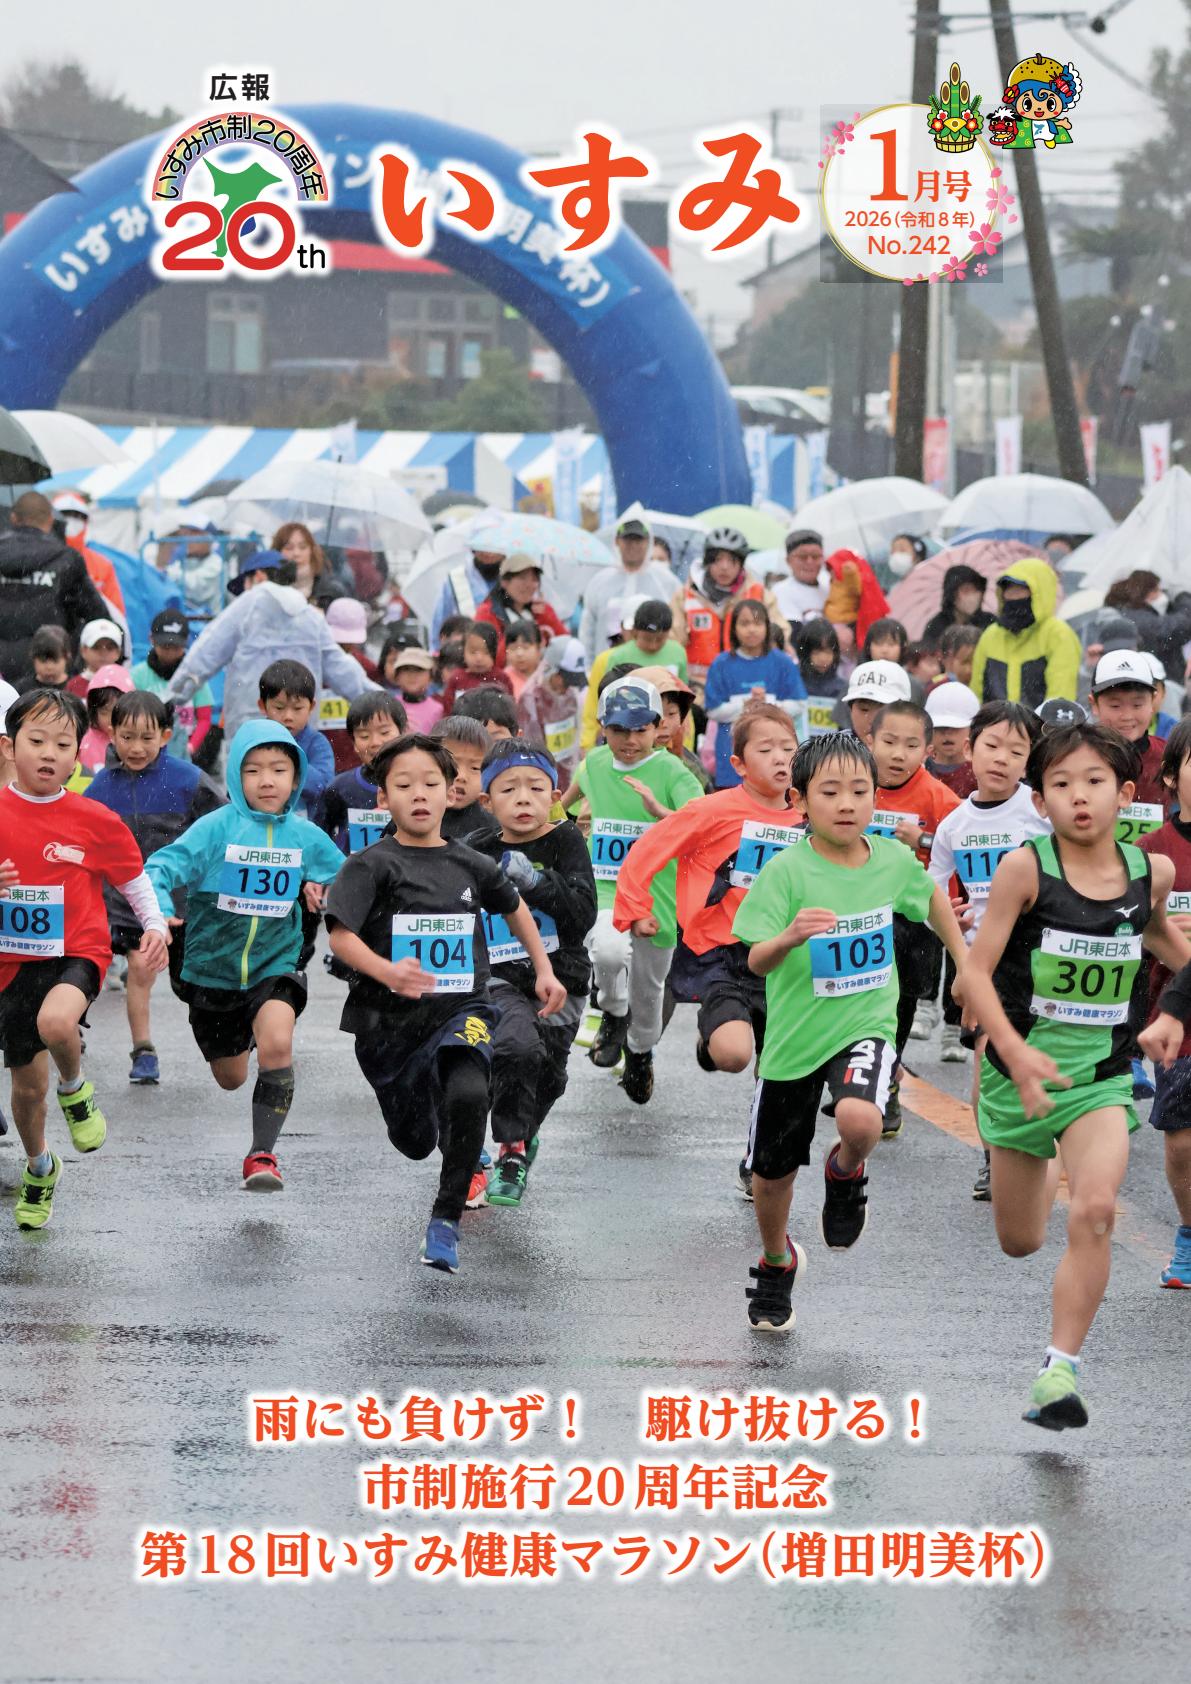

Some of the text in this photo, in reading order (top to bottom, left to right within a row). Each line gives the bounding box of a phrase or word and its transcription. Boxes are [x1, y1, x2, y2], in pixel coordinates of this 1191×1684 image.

[857, 672, 887, 686] GAP
[597, 822, 644, 835] JR東日本
[961, 833, 1012, 846] JR東日本
[239, 849, 292, 865] JR東日本
[238, 868, 290, 897] 130
[8, 888, 50, 902] 東日本
[408, 918, 465, 932] JR東日本
[409, 938, 467, 969] 104
[828, 933, 886, 972] 103
[1060, 938, 1131, 957] JR東日本
[1052, 960, 1125, 998] 301
